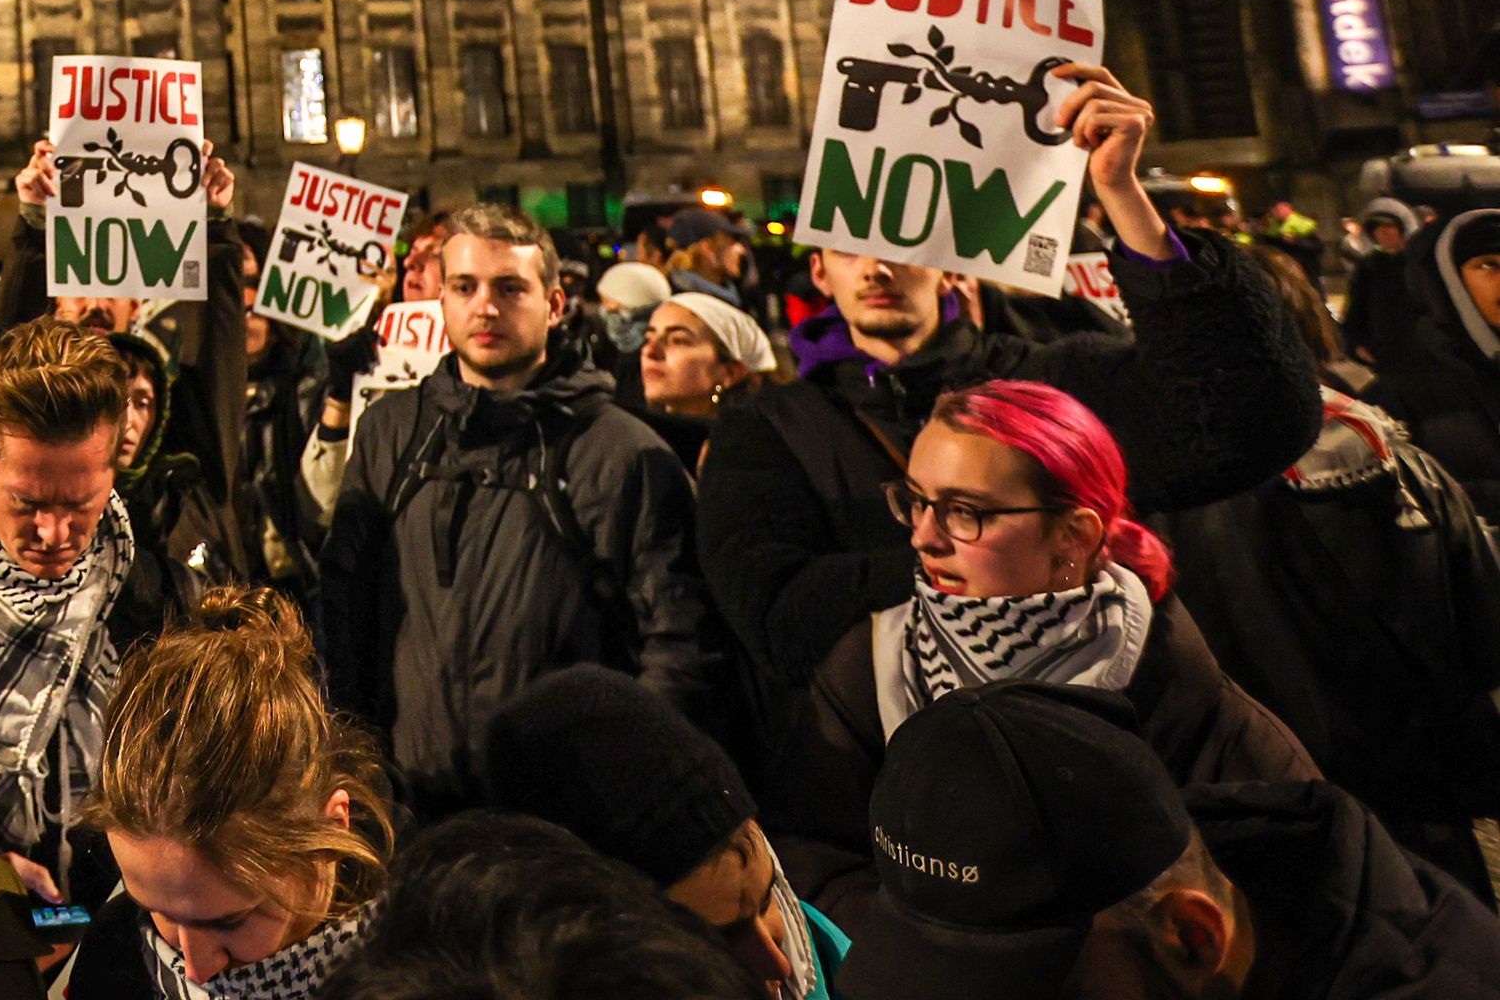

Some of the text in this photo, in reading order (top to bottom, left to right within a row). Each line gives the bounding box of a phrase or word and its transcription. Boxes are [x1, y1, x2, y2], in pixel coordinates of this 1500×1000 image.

[58, 66, 198, 126] JUSTICE
[290, 170, 401, 236] JUSTICE
[810, 138, 1067, 265] NOW
[54, 215, 198, 287] NOW
[261, 265, 369, 331] NOW
[875, 826, 979, 883] christiansø
